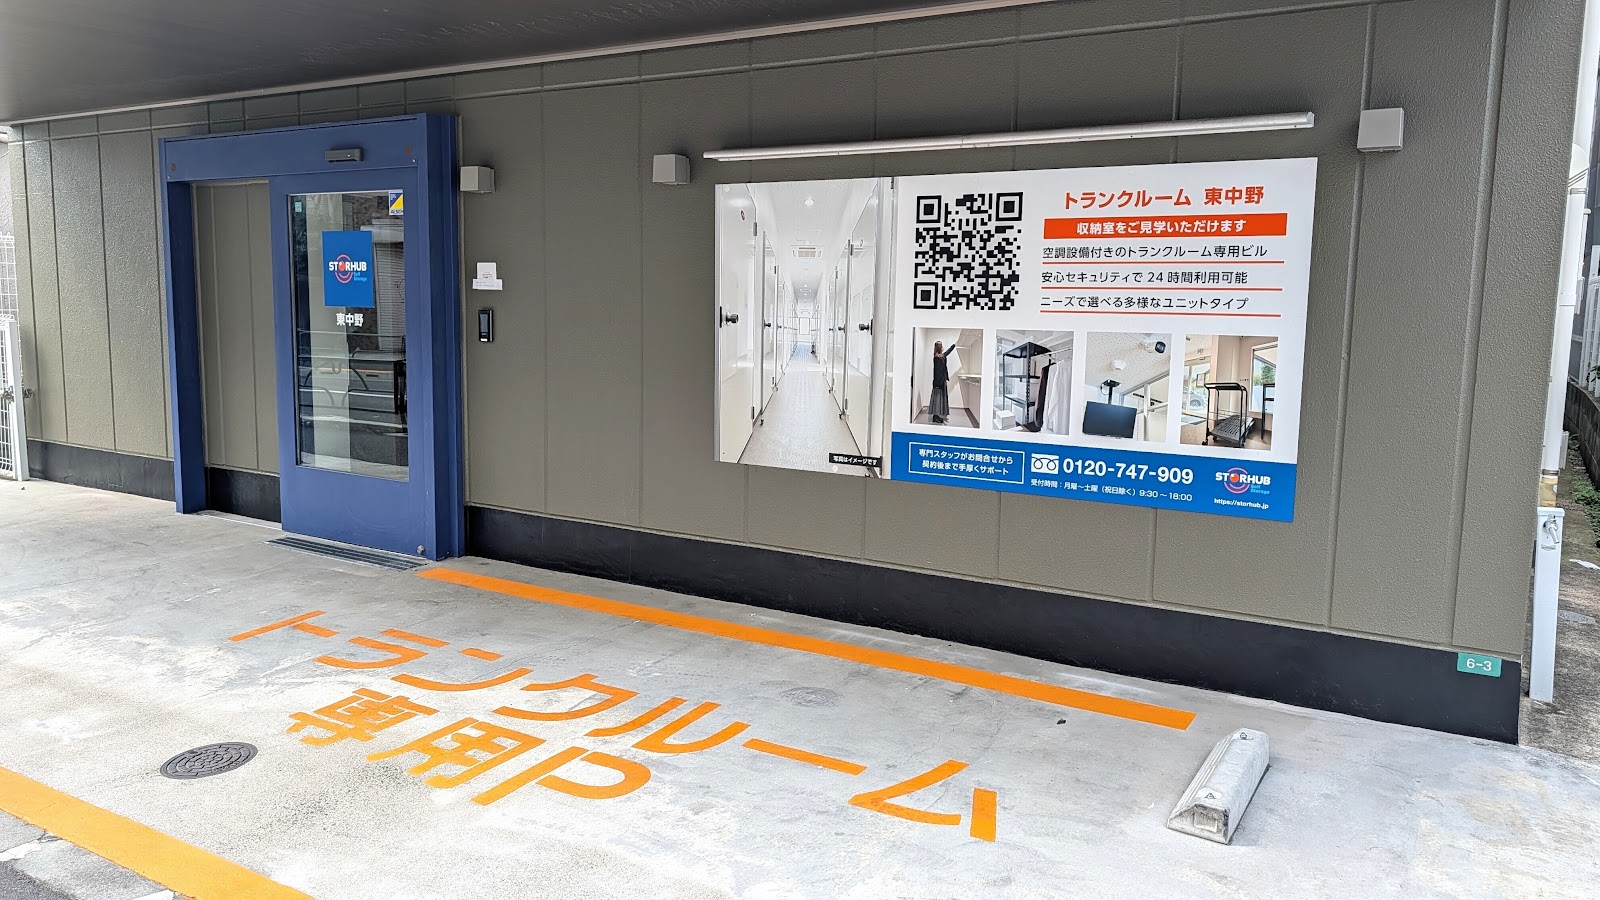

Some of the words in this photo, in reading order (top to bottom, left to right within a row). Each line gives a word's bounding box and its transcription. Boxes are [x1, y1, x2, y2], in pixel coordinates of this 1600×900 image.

[1065, 188, 1192, 209] トランクルーム
[1203, 185, 1265, 206] 東中野
[1076, 219, 1247, 235] 収納室をご見学いただけます
[1042, 245, 1268, 259] 空調設備付きのトランクルーム専用ビル
[328, 260, 367, 271] STORHUB
[1040, 296, 1249, 310] ニーズで選べる多様なユニットタイプ
[336, 312, 364, 327] 東中野
[918, 448, 1013, 465] 専門スタッフがお問合せから
[922, 460, 1009, 476] 契約後まで手厚くサポート
[1063, 458, 1194, 485] 0120-747-909
[1215, 471, 1271, 485] STORHUB
[1214, 498, 1269, 510] https://storhub.jp
[1466, 658, 1492, 672] 6-3
[229, 610, 998, 843] トランクルーム
[287, 687, 652, 806] 専用P
